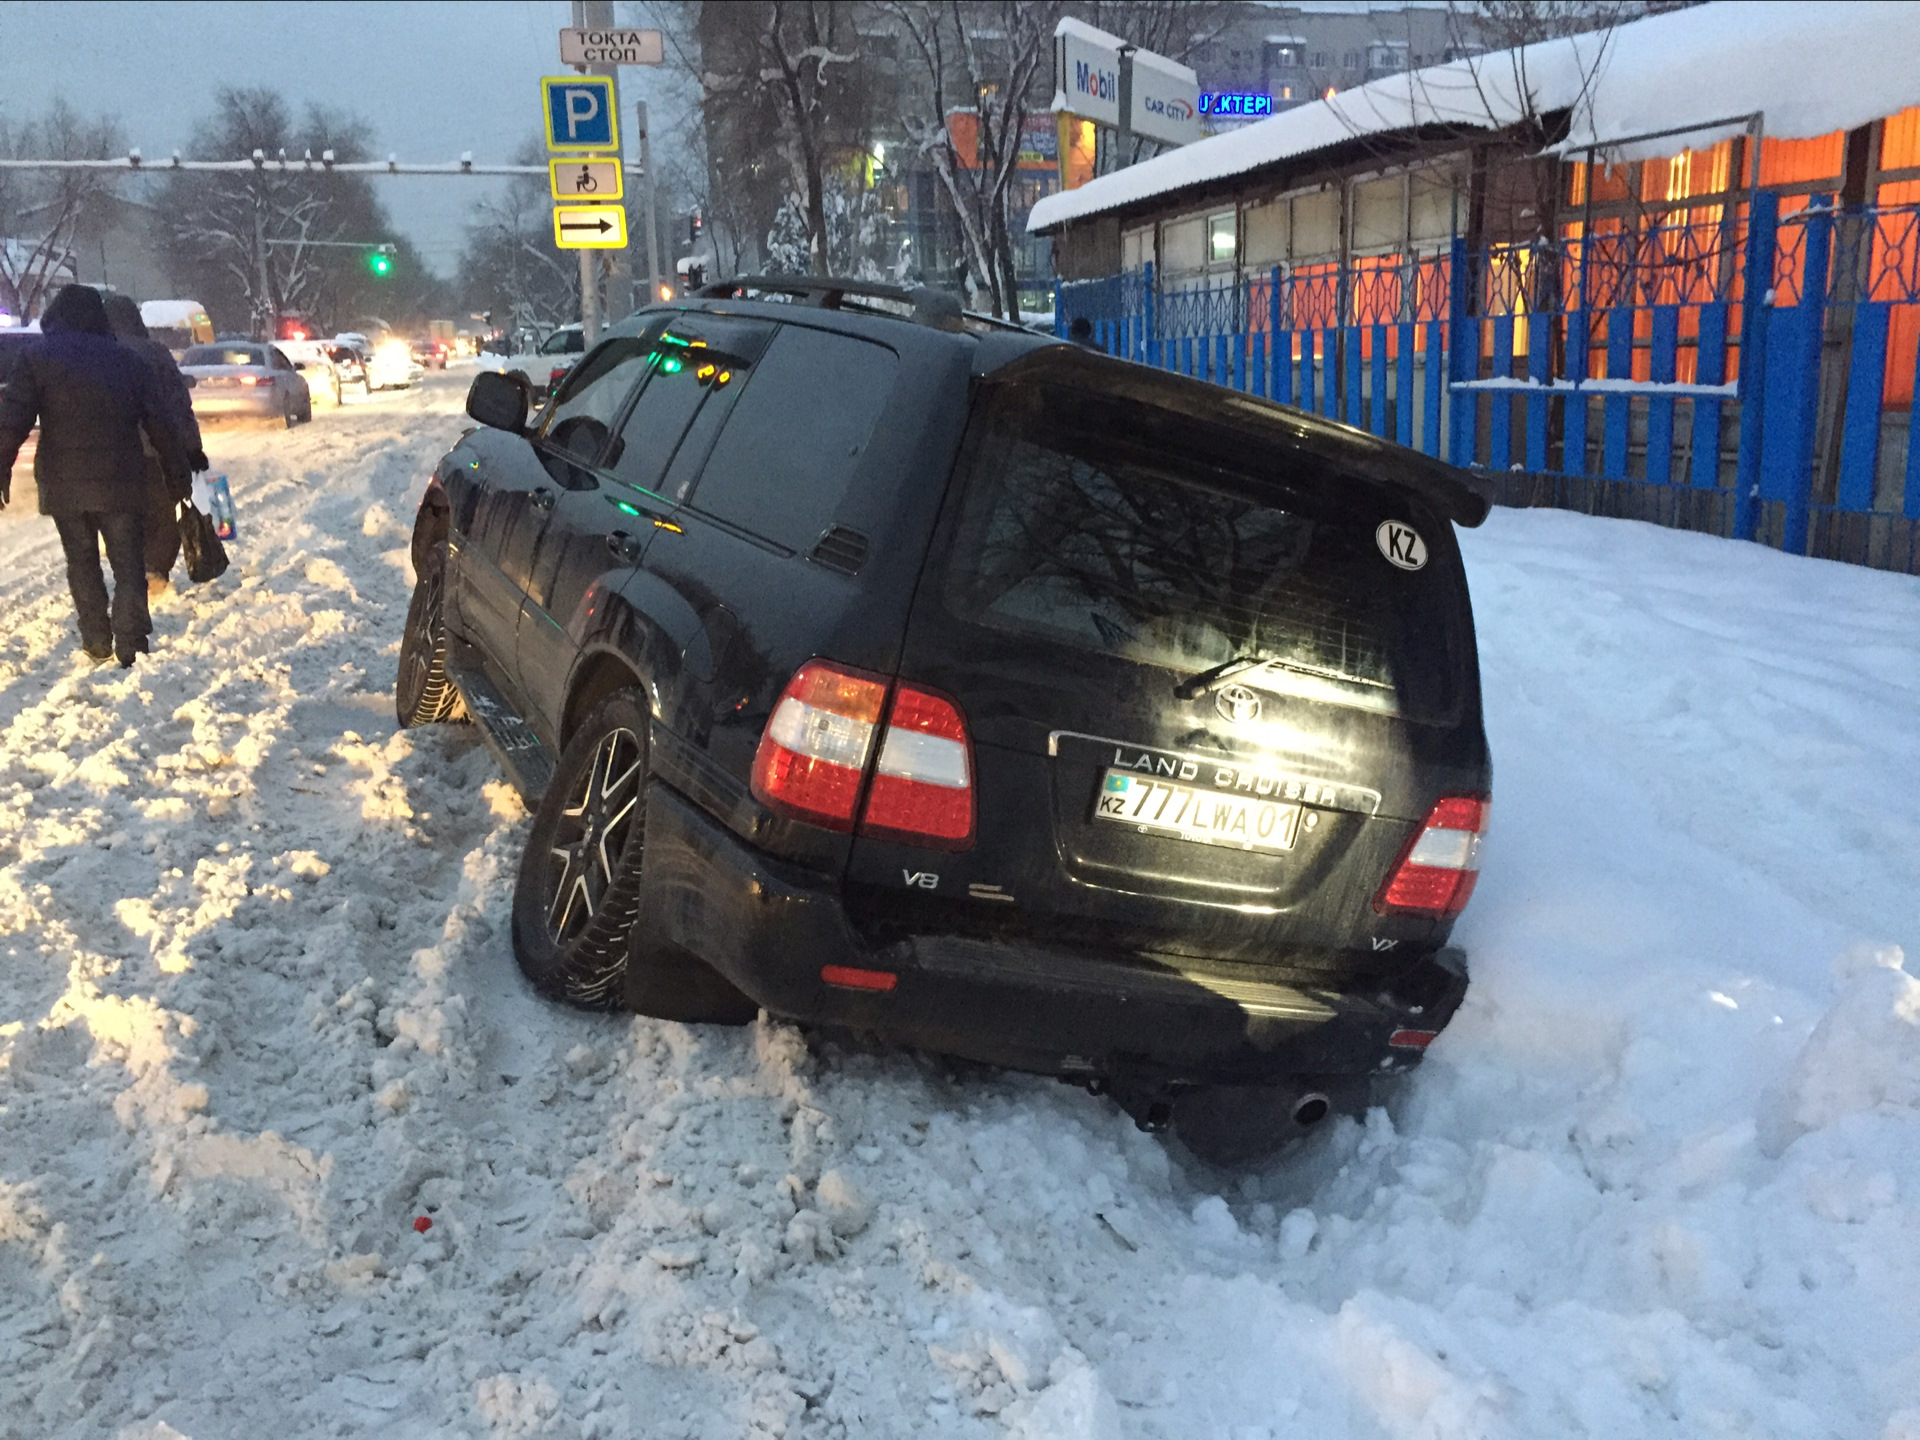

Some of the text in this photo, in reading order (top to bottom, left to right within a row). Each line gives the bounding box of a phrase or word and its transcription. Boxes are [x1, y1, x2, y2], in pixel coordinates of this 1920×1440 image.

[577, 31, 641, 47] ТОҚТА
[584, 47, 637, 62] СТОП
[1076, 59, 1115, 103] Mobil
[565, 89, 599, 138] P
[1145, 96, 1186, 122] CAR CITY
[1388, 524, 1418, 565] KZ
[1113, 748, 1337, 806] LAND CRUISER
[1100, 795, 1126, 815] KZ
[902, 868, 939, 890] V8
